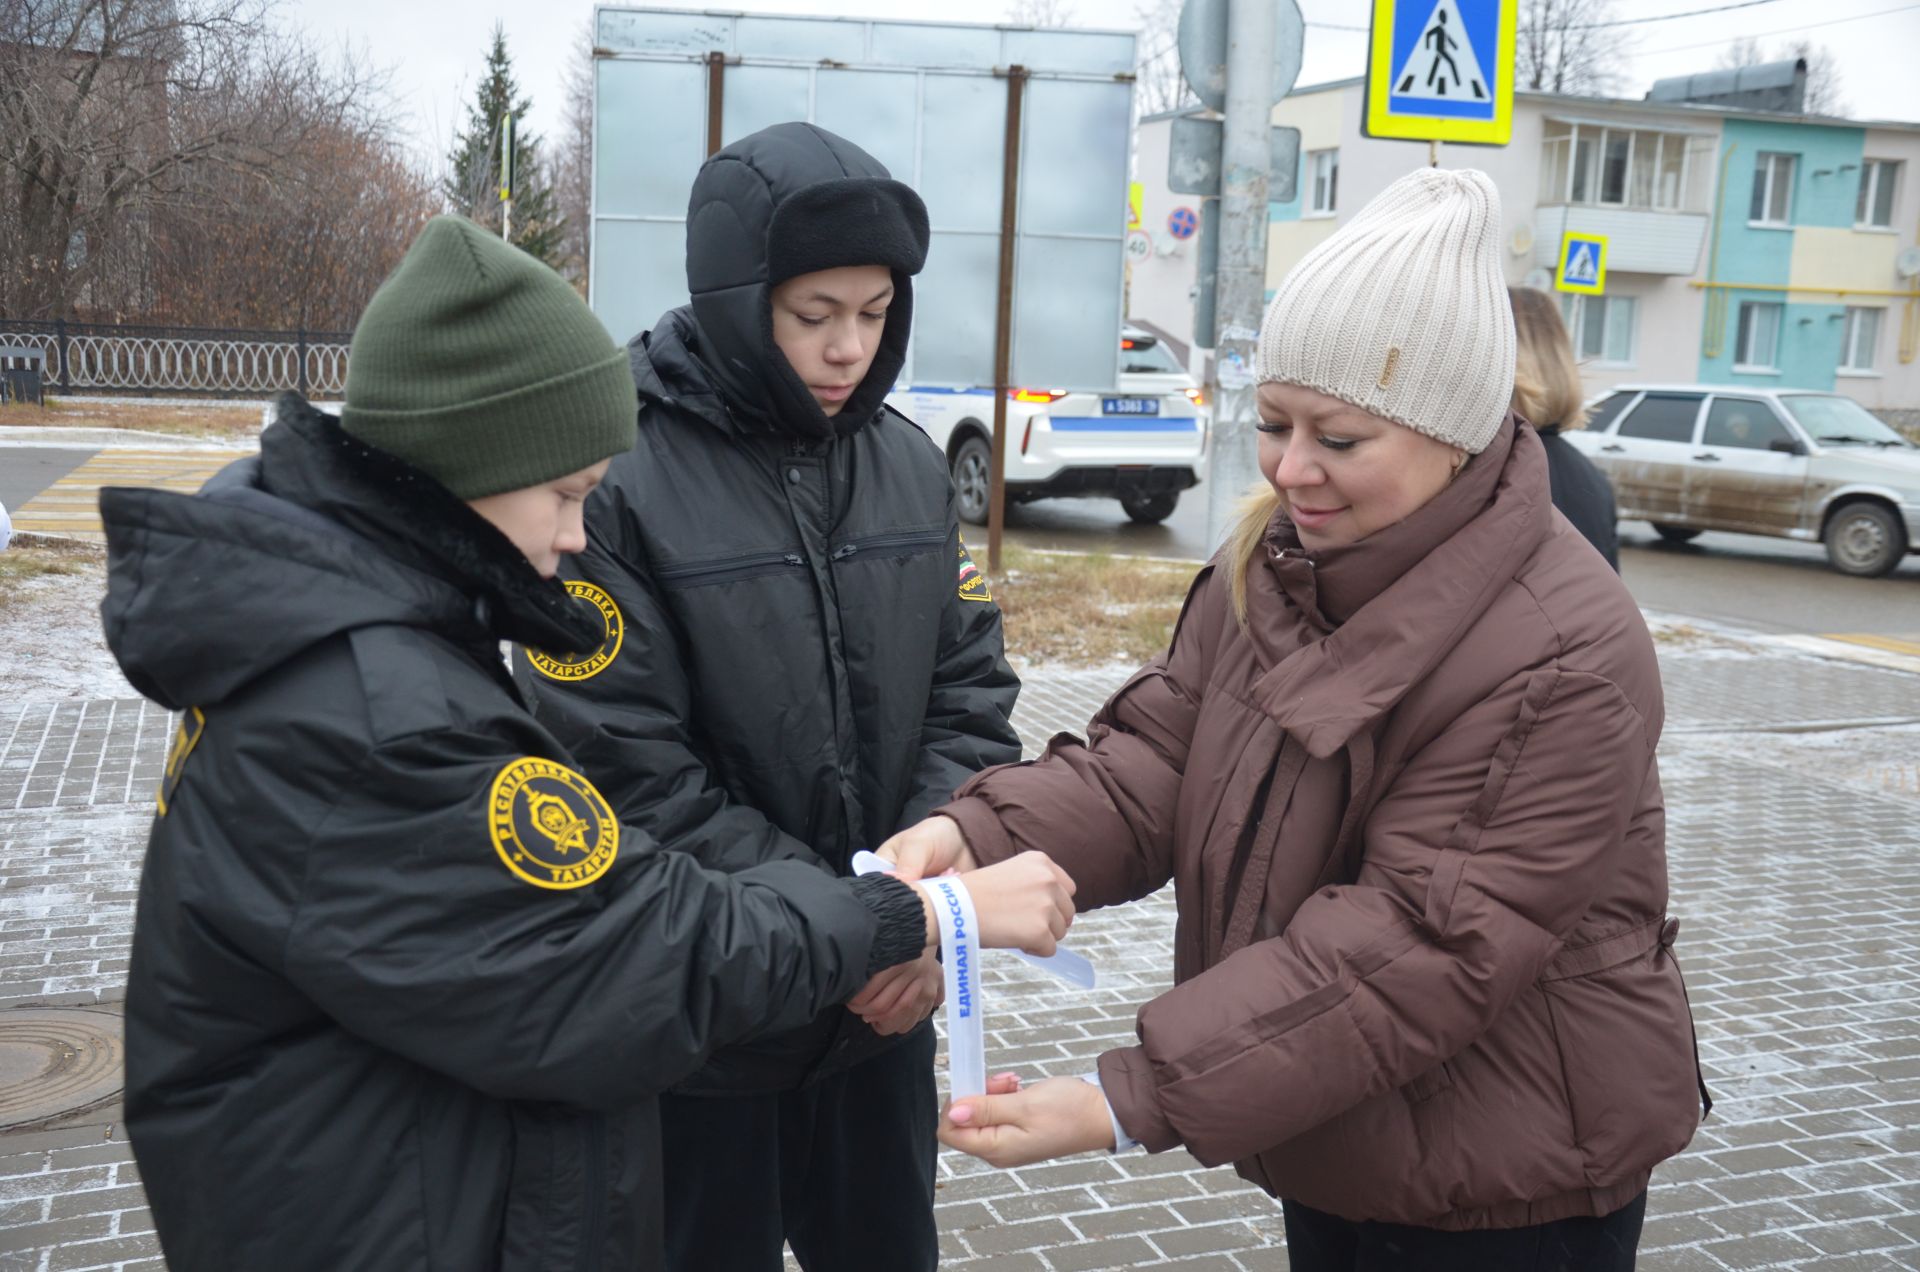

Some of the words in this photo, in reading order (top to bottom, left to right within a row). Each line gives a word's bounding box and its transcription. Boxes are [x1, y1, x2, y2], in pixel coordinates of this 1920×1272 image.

[1129, 240, 1147, 255] 40
[536, 652, 608, 676] ТАТАРСТАН
[551, 818, 614, 882] ТАТАРСТАН
[938, 882, 966, 940] РОССИЯ
[955, 944, 972, 1018] ЕДИНАЯ
